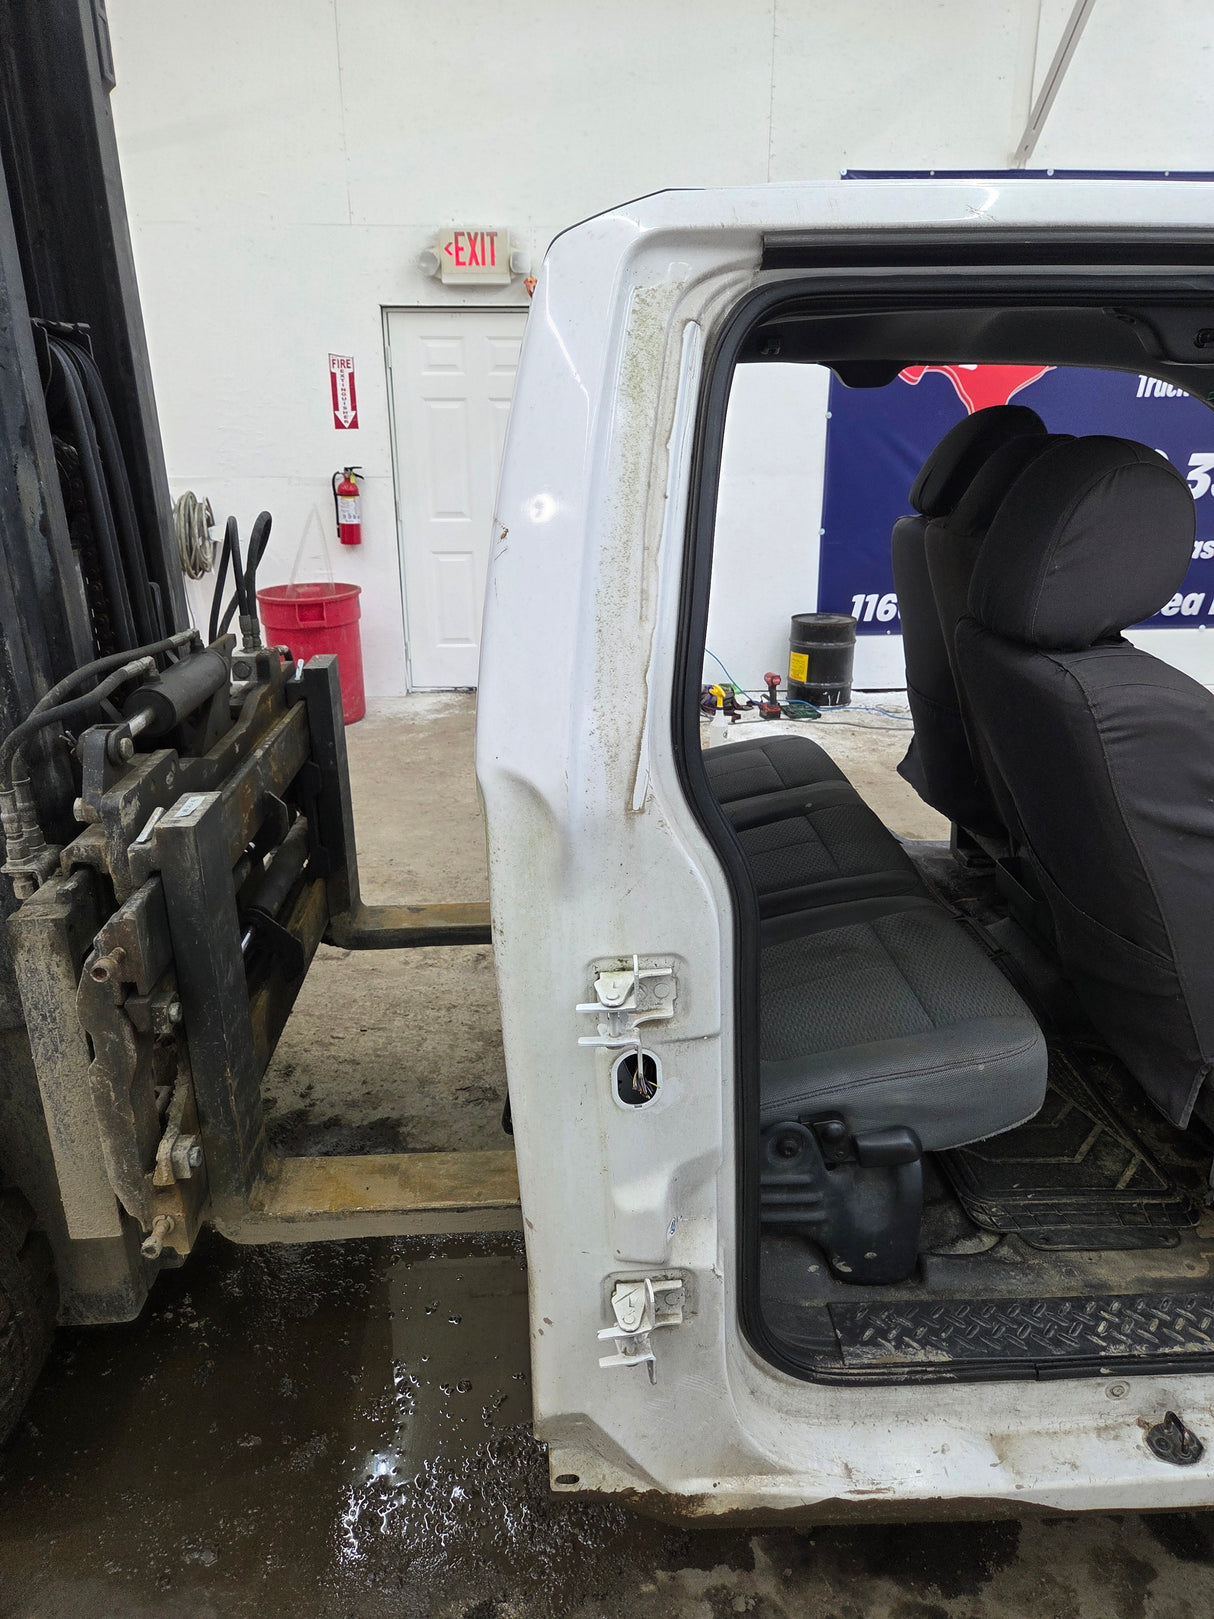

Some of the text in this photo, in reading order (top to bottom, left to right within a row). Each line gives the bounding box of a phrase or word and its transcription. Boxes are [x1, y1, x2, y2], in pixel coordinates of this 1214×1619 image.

[454, 231, 498, 267] EXIT
[331, 358, 352, 369] FIRE
[340, 369, 349, 424] EXTINGUISHER
[851, 593, 901, 622] 116
